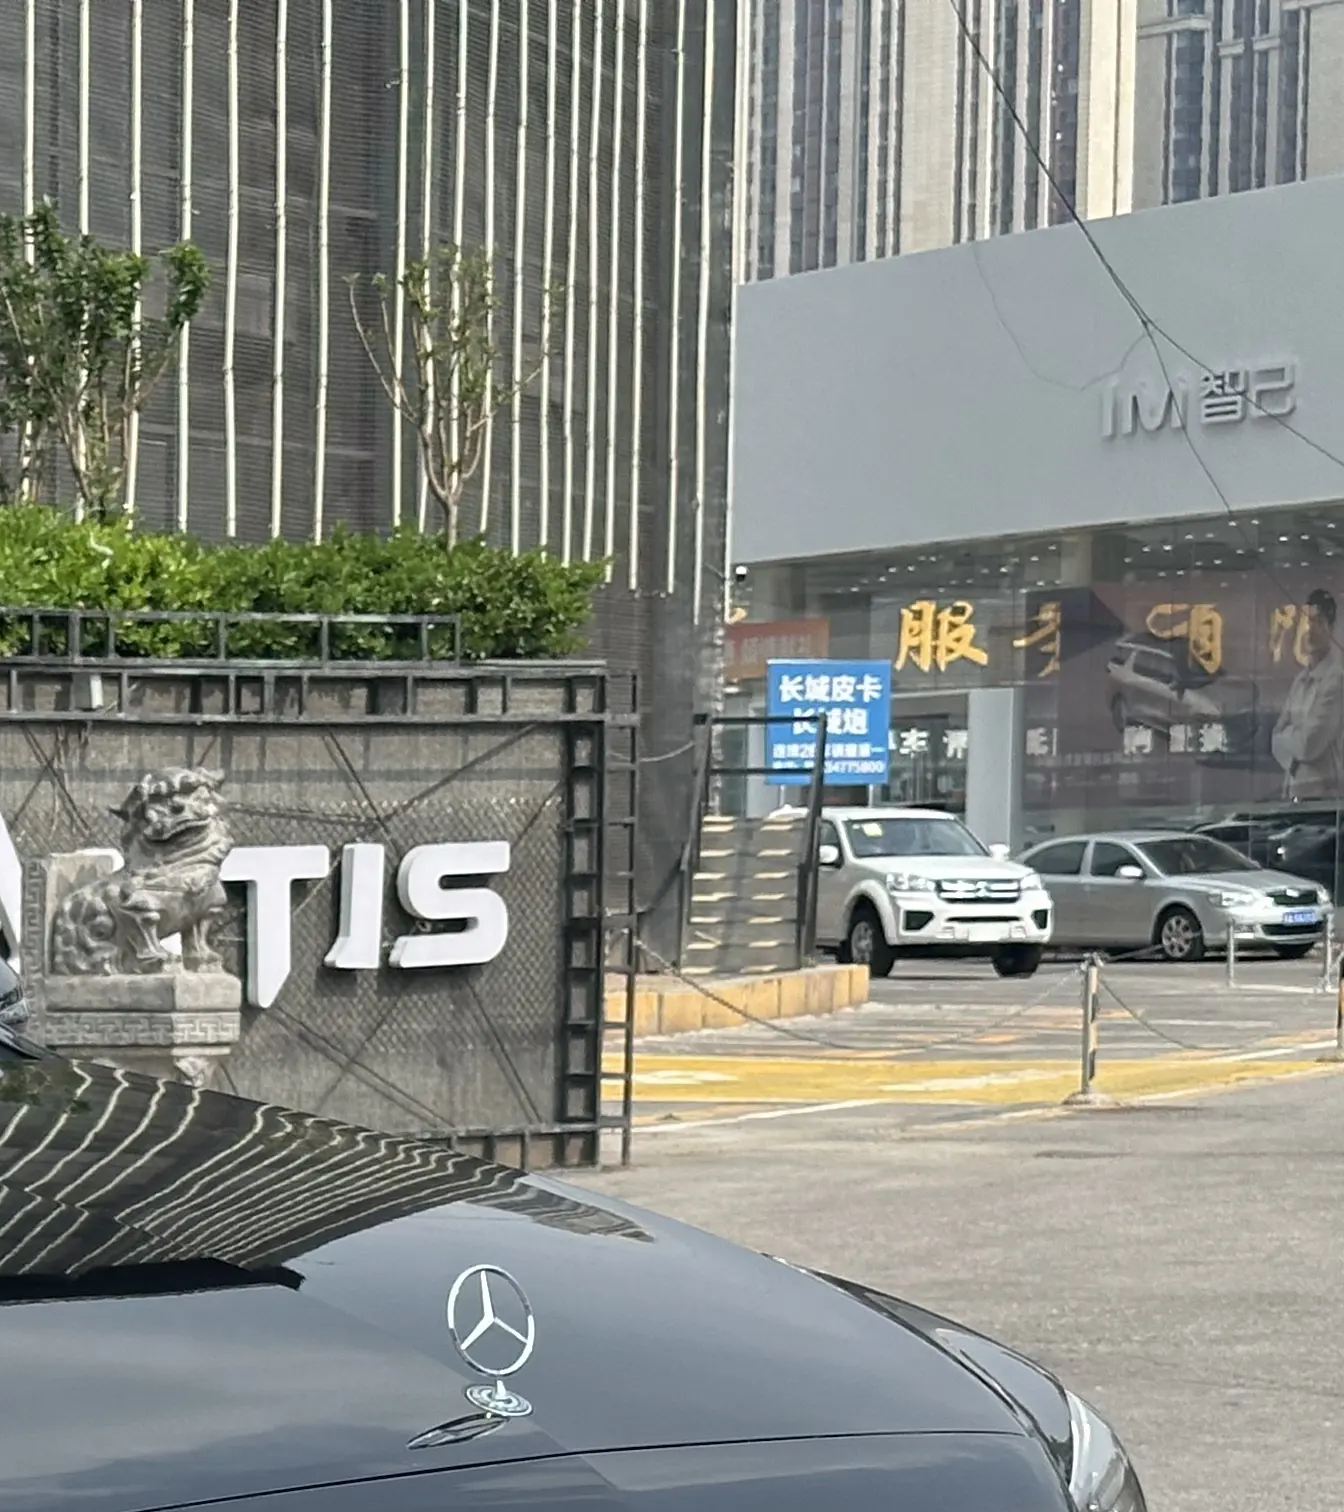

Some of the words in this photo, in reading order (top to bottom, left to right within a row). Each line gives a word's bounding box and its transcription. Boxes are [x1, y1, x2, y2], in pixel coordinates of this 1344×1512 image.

[1199, 363, 1296, 424] 智己
[779, 674, 883, 703] 长城皮卡
